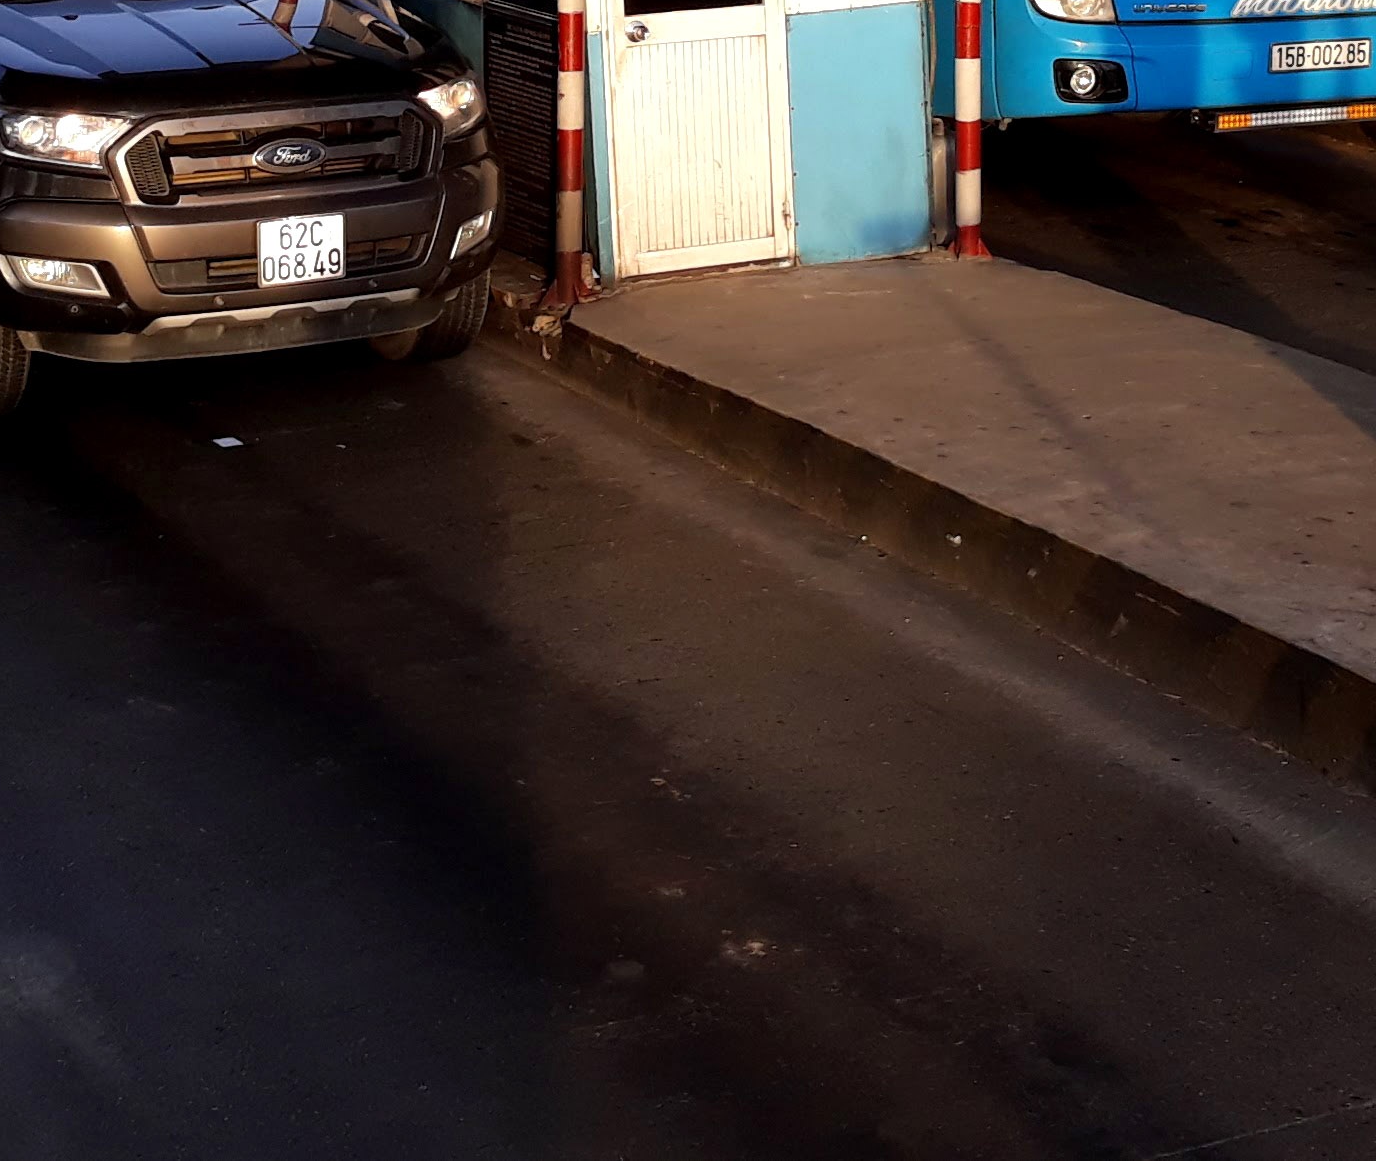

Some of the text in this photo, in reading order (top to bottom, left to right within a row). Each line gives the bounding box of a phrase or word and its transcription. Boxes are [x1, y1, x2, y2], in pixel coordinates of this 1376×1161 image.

[1275, 42, 1368, 69] 15B-002.85
[273, 146, 312, 166] Ford
[279, 220, 323, 251] 62C
[262, 247, 342, 283] 068.49
